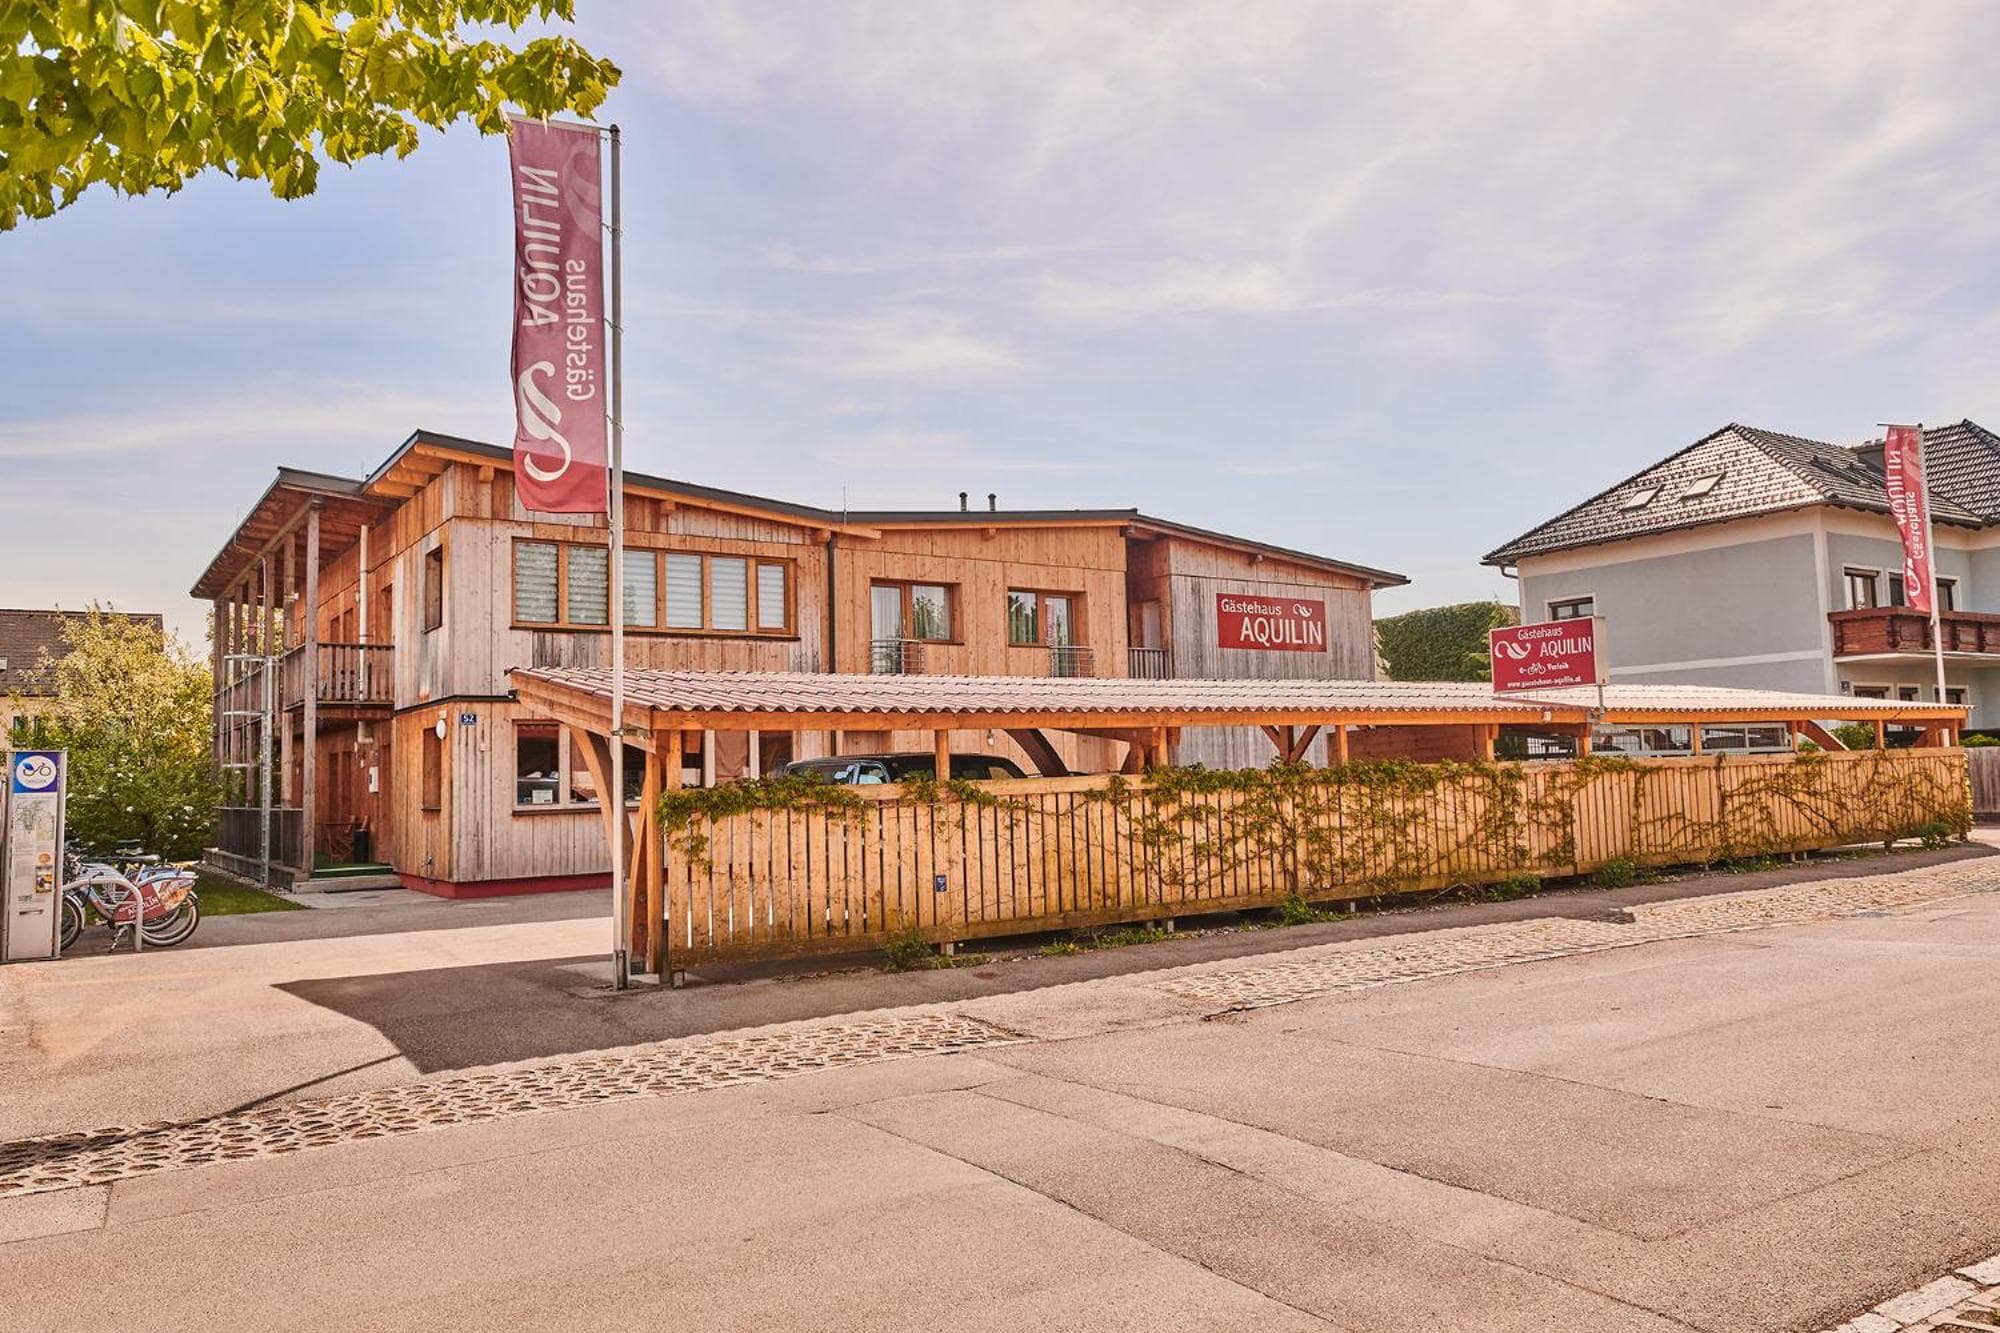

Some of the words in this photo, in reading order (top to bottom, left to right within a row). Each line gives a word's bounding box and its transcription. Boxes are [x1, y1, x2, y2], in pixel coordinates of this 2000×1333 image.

[1221, 599, 1282, 616] Gästehaus
[1240, 616, 1322, 647] AQUILIN
[1518, 626, 1563, 640] Gästehaus
[1540, 636, 1592, 658] AQUILIN
